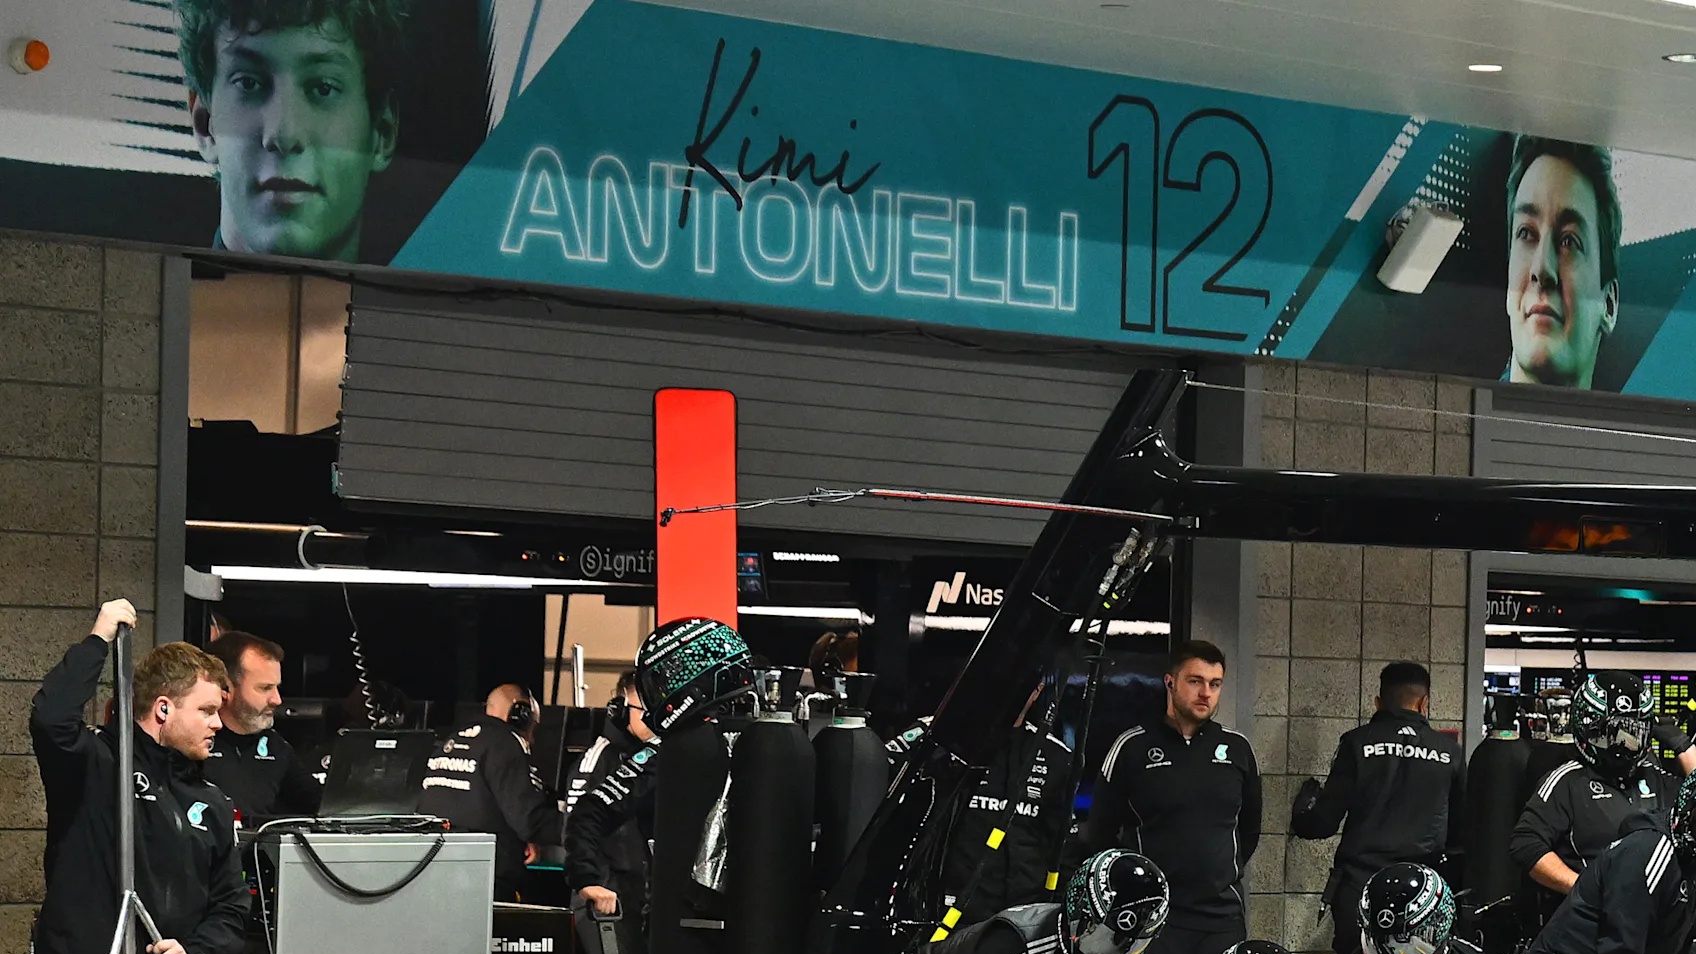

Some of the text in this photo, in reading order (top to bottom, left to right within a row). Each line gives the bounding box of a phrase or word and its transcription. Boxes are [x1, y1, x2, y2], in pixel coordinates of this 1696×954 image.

[679, 38, 882, 229] Kimi
[500, 146, 1079, 313] ANTONELLI
[1087, 94, 1273, 342] 12
[965, 583, 1004, 605] Nas
[661, 696, 695, 730] Einhell
[1363, 742, 1451, 764] PETRONAS
[968, 795, 1040, 818] ETRONAS
[491, 937, 554, 953] Einhell
